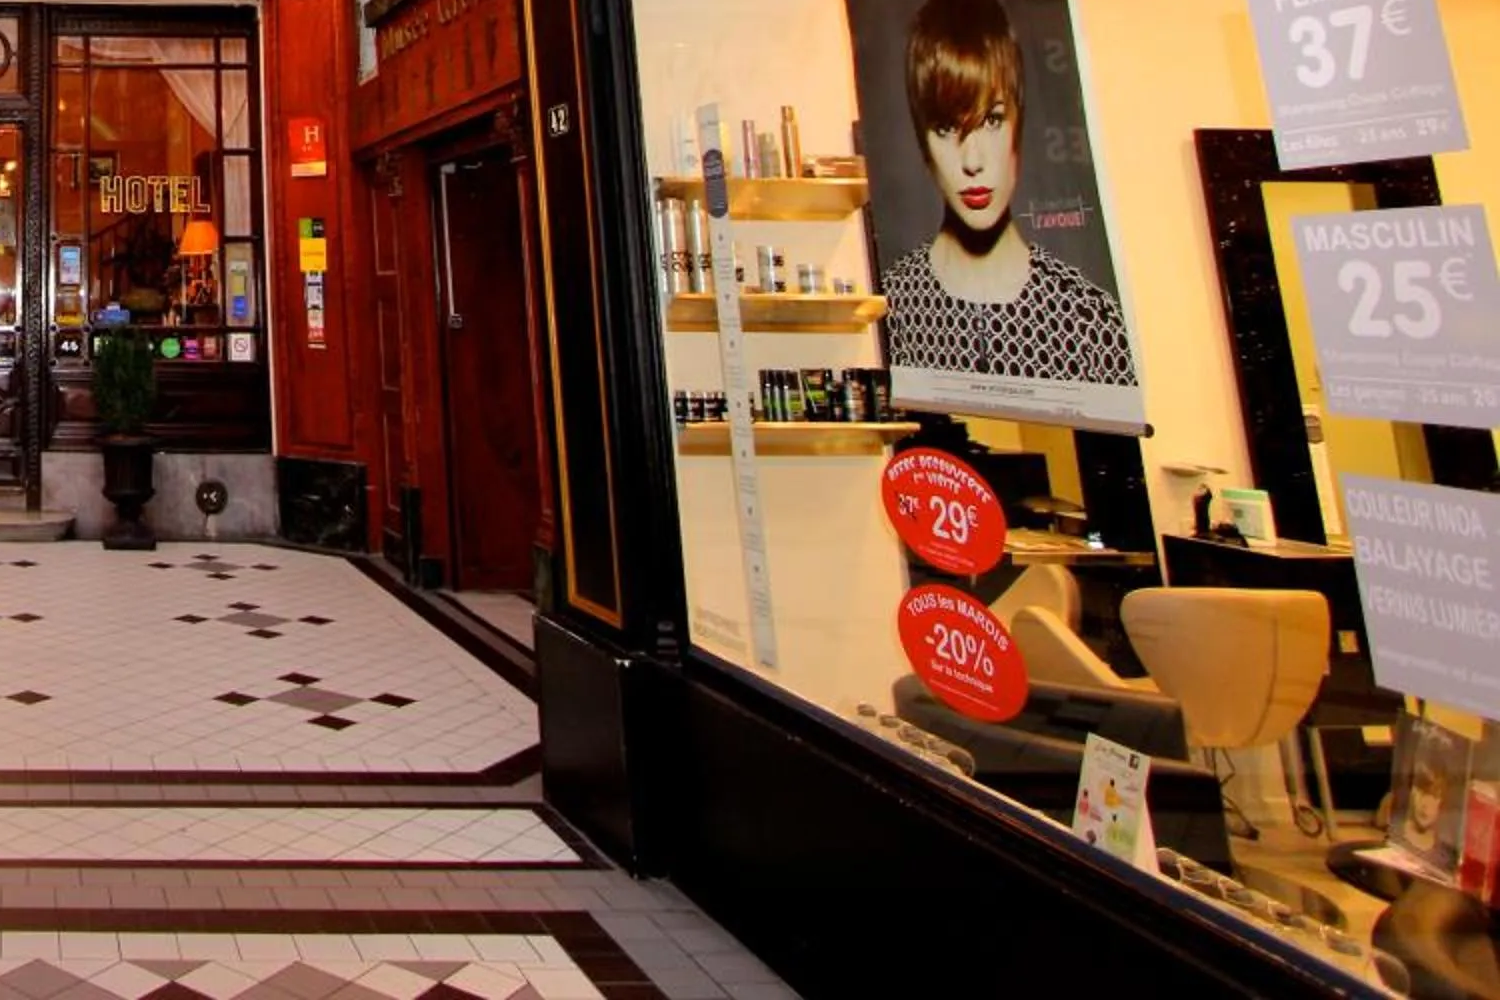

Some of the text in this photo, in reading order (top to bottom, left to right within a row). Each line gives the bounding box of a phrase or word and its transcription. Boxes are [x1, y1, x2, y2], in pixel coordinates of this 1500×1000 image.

[304, 125, 319, 144] H
[100, 175, 211, 213] HOTEL
[1303, 216, 1475, 252] MASCULIN
[1355, 535, 1494, 591] BALAYAGE
[906, 593, 938, 616] TOUS
[925, 623, 994, 677] -20%
